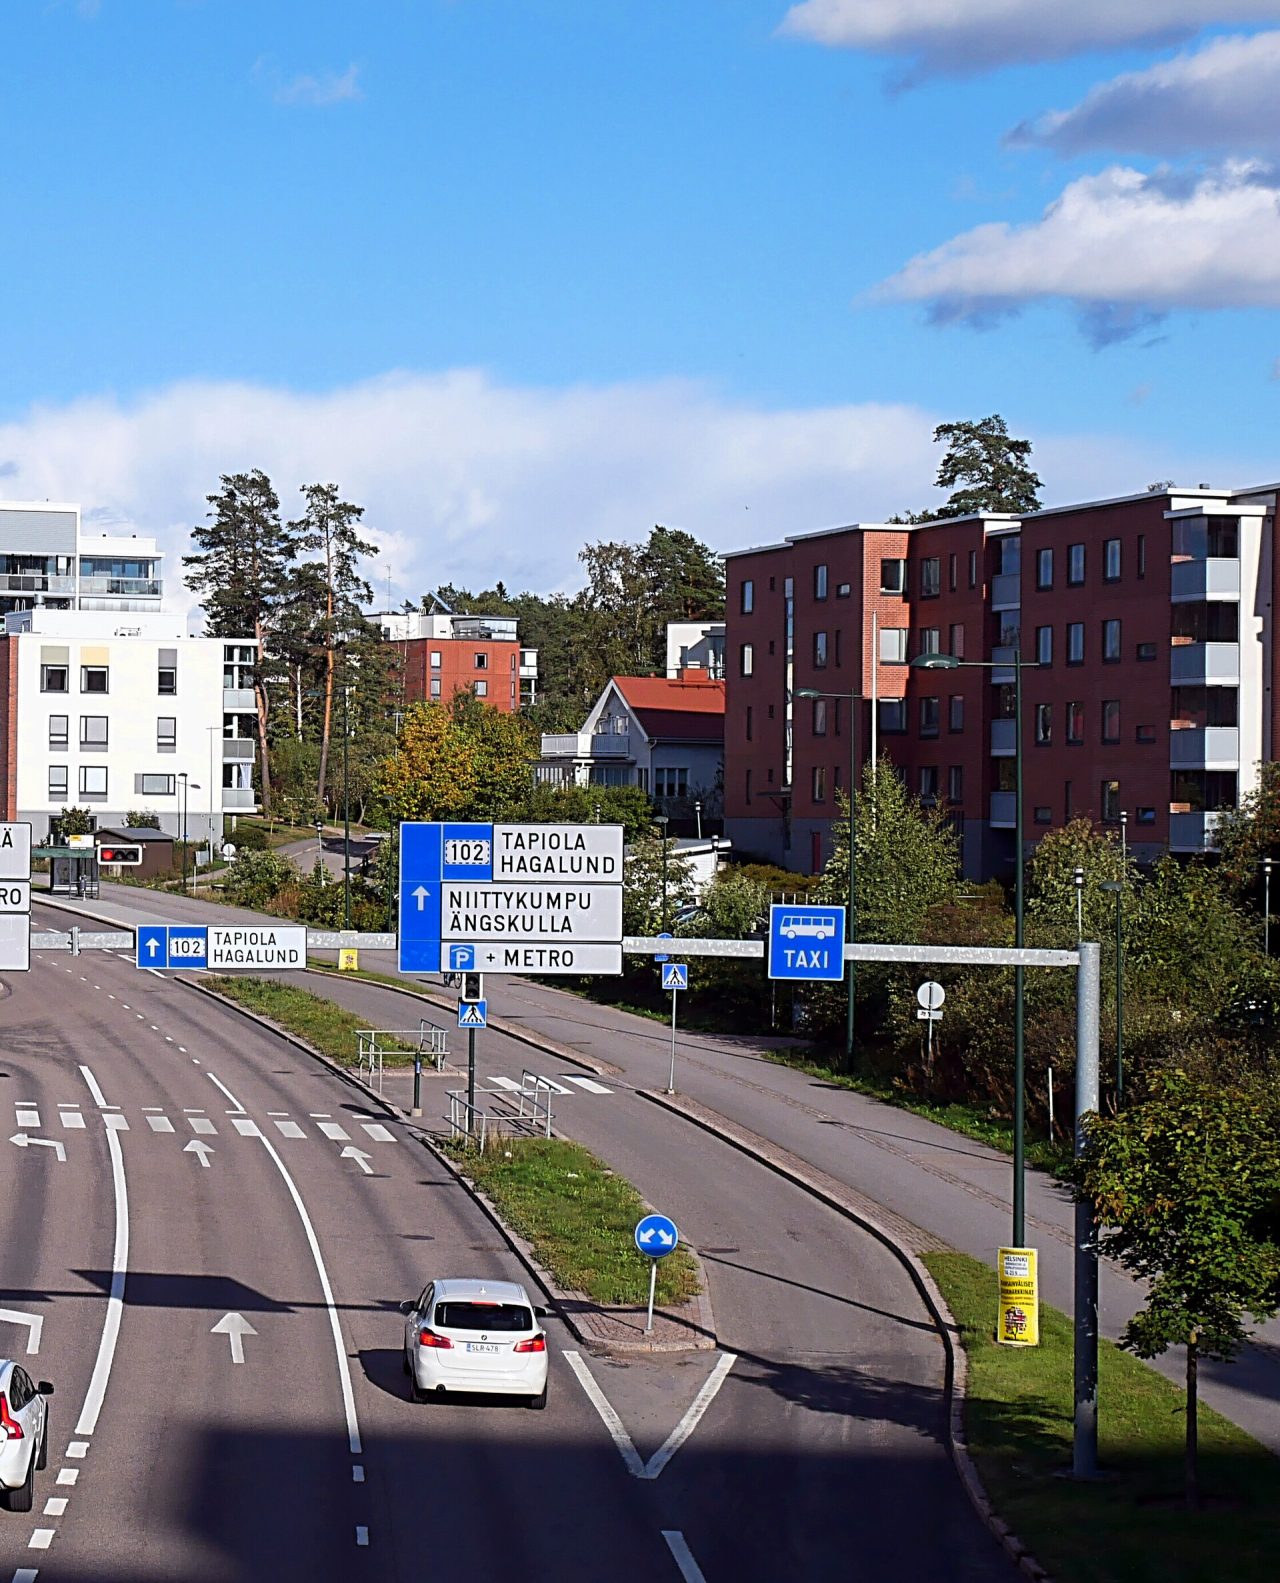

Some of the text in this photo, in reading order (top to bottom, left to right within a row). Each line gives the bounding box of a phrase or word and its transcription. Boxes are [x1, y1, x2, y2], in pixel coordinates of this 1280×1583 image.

[502, 833, 585, 850] TAPIOLA
[452, 844, 483, 860] 102
[502, 856, 614, 873] HAGALUND
[450, 891, 590, 909] NIITTYKUMPU
[450, 911, 572, 932] ÄNGSKULLA
[176, 941, 200, 953] 102
[214, 933, 276, 945] TAPIOLA
[214, 949, 298, 962] HAGALUND
[505, 950, 573, 966] METRO
[784, 950, 828, 968] TAXI
